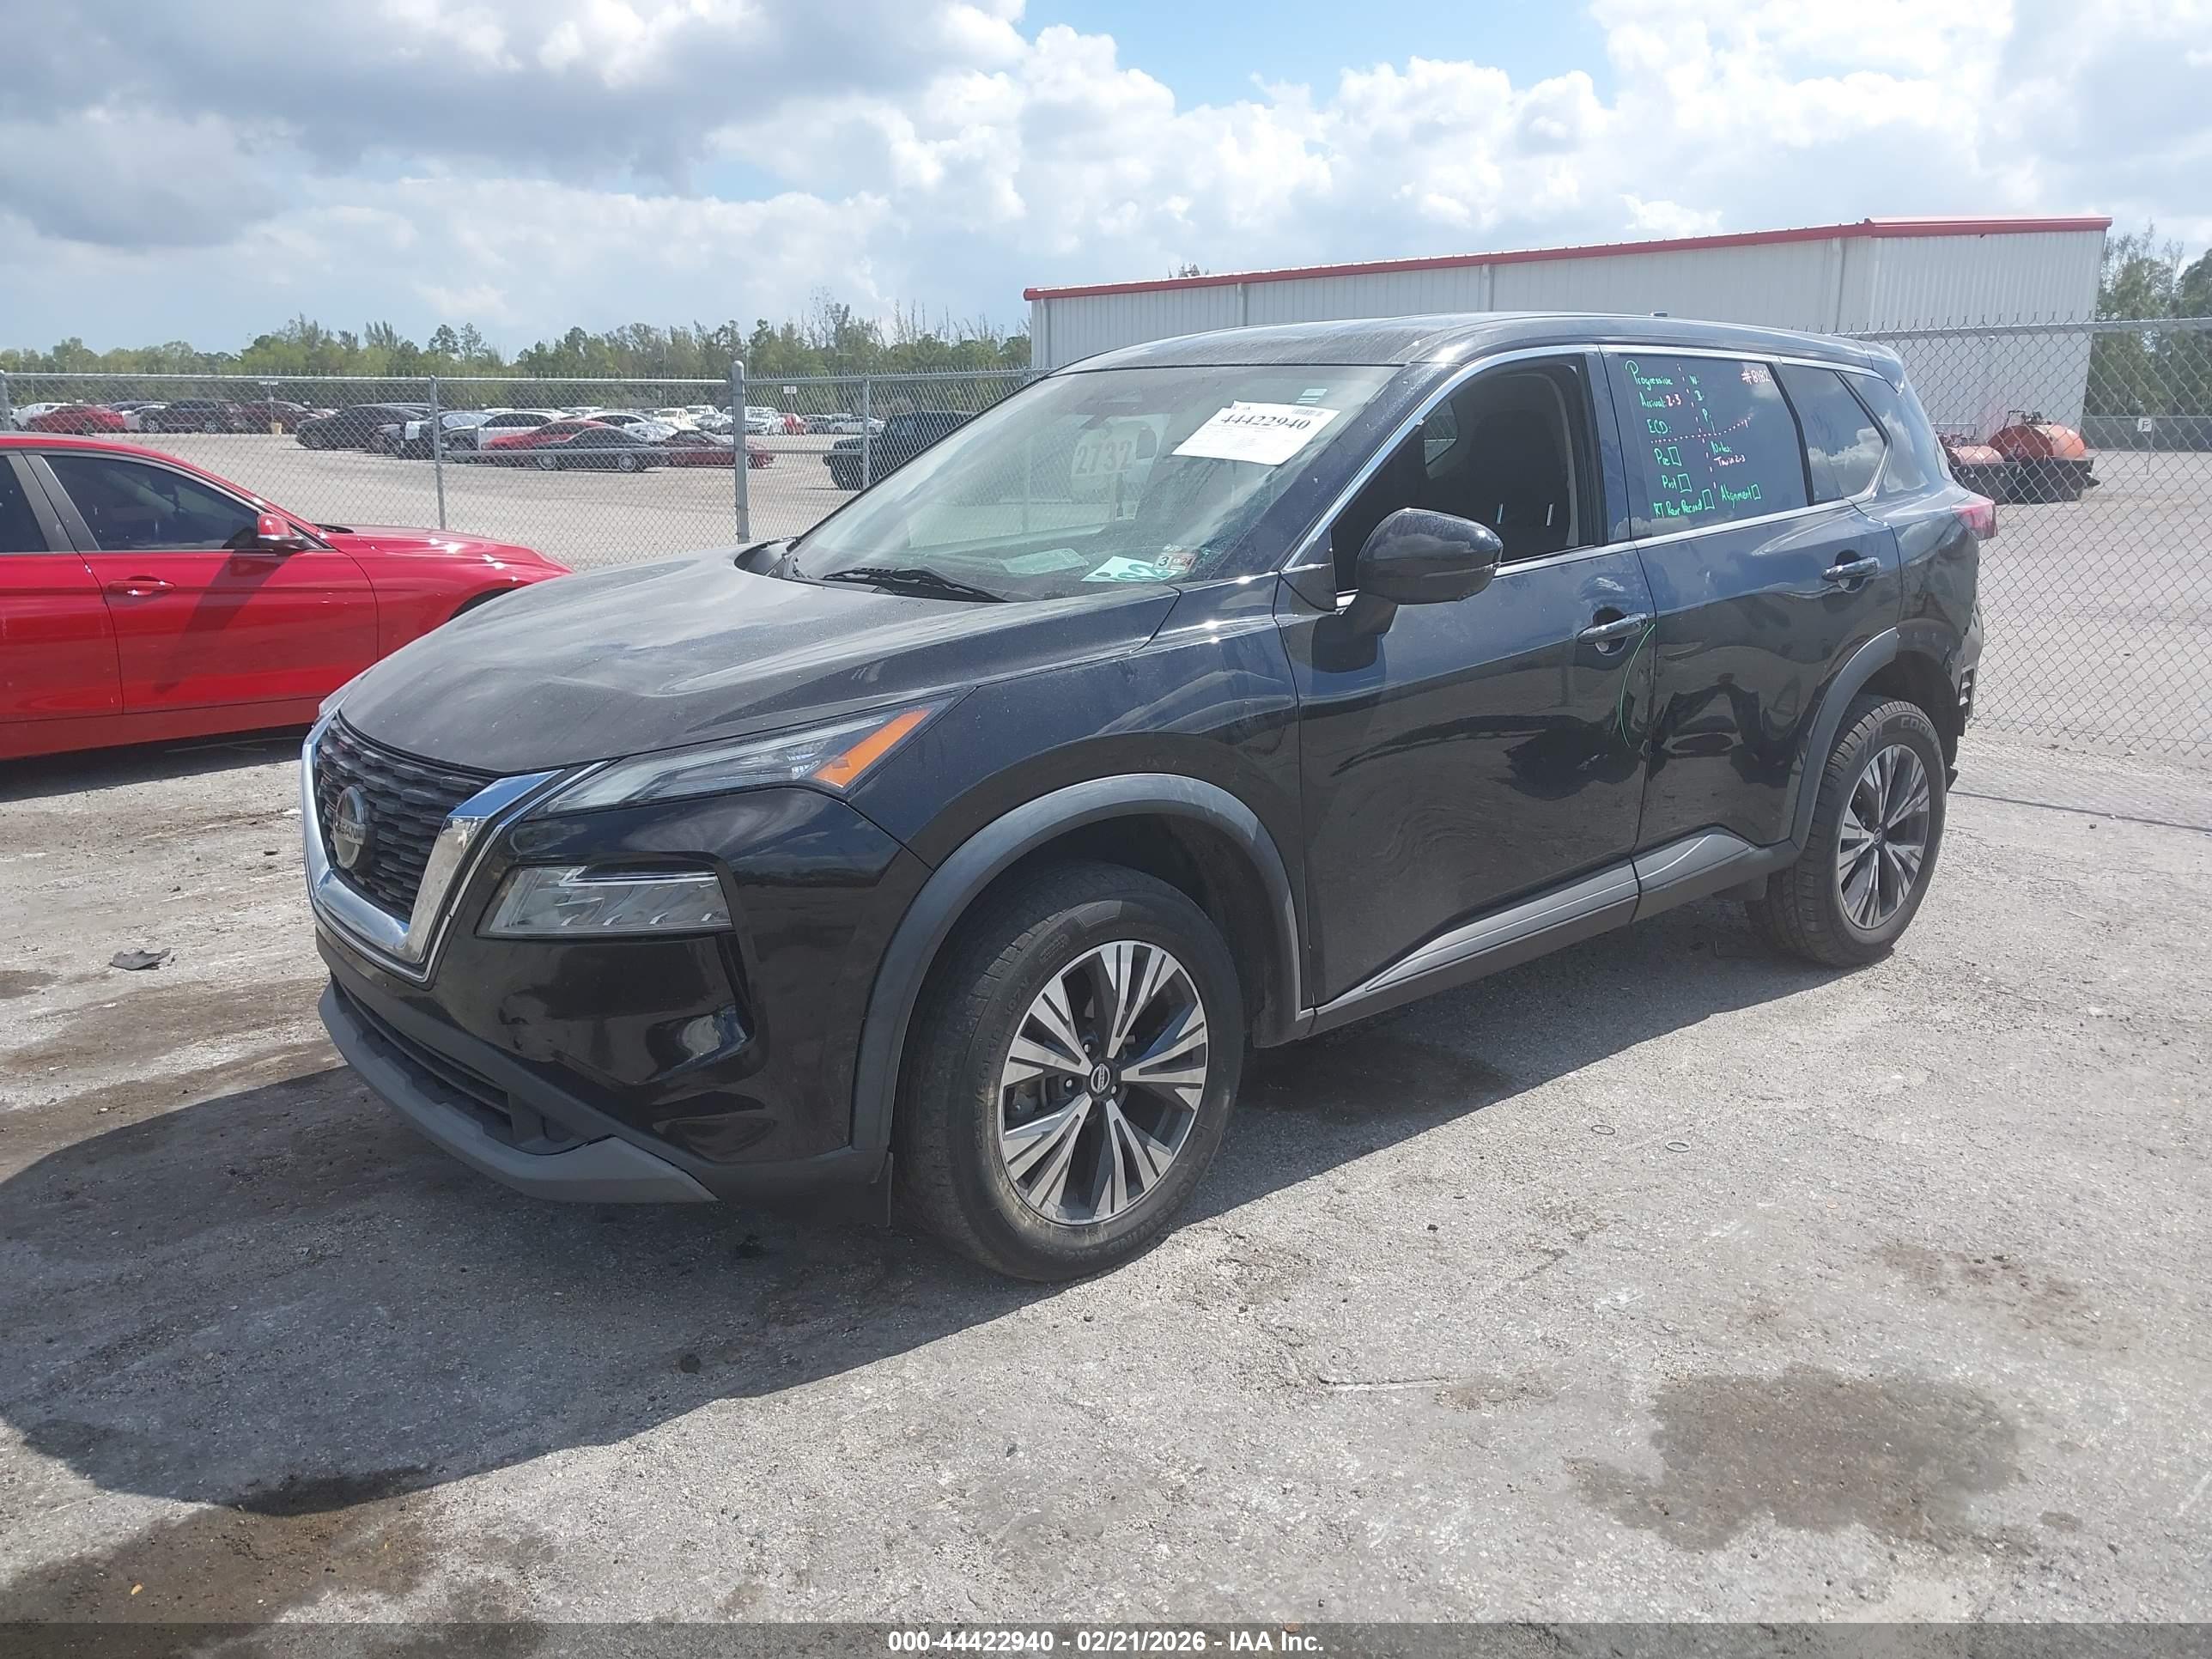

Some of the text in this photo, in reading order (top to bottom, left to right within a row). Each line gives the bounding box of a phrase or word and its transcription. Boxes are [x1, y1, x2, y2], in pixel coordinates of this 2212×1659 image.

[1626, 360, 1674, 391] Progressive
[1741, 369, 1771, 386] #8182
[1220, 414, 1311, 429] 44422940
